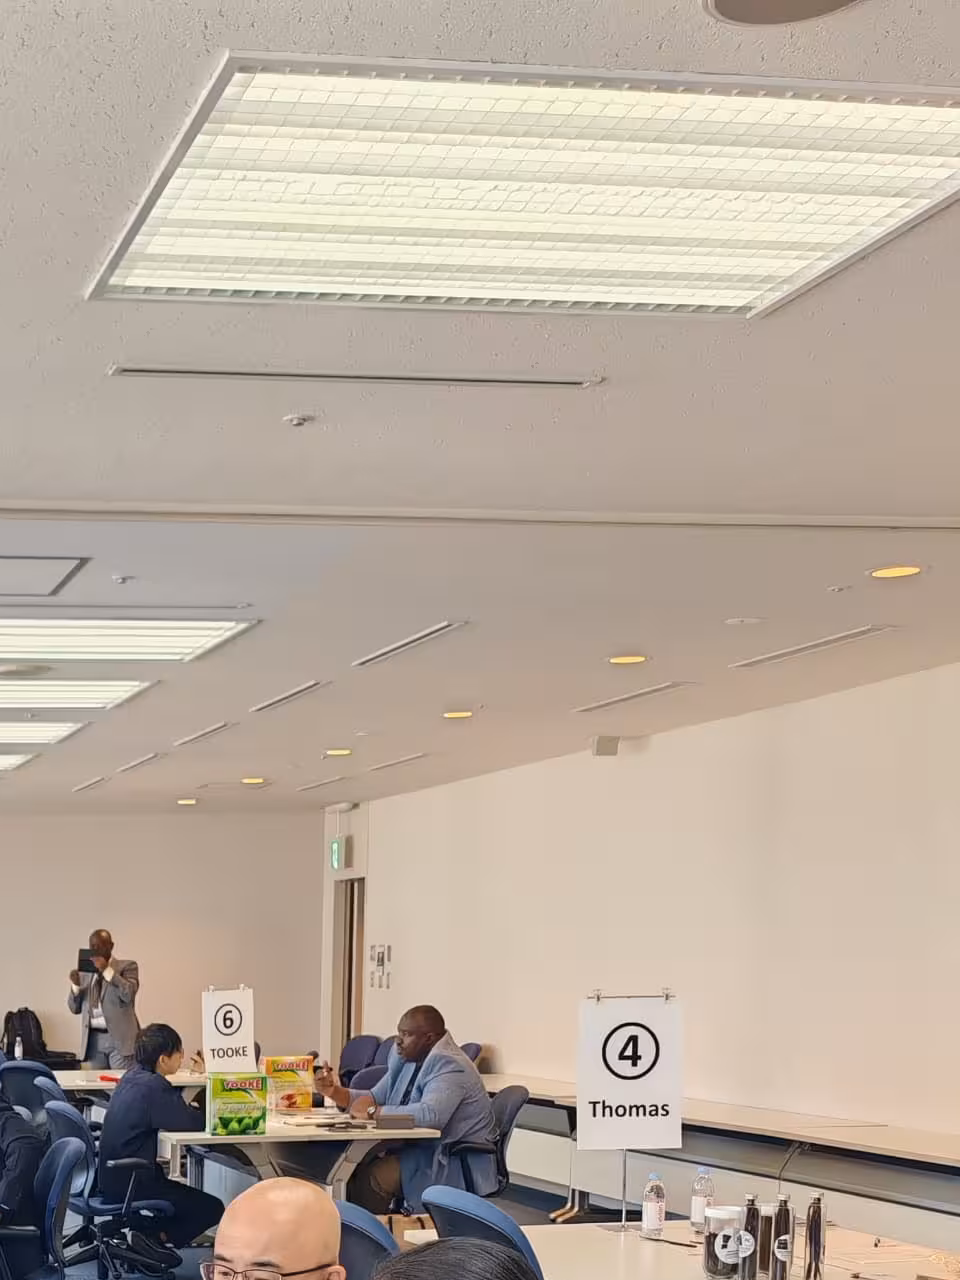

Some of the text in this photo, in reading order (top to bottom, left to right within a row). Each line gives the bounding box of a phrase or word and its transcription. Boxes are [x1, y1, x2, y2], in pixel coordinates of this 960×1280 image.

[223, 1010, 234, 1029] 6
[210, 1046, 248, 1060] TOOKE
[618, 1034, 642, 1067] 4
[275, 1061, 309, 1072] TOOKE
[224, 1079, 262, 1090] TOOKE
[588, 1100, 670, 1118] Thomas
